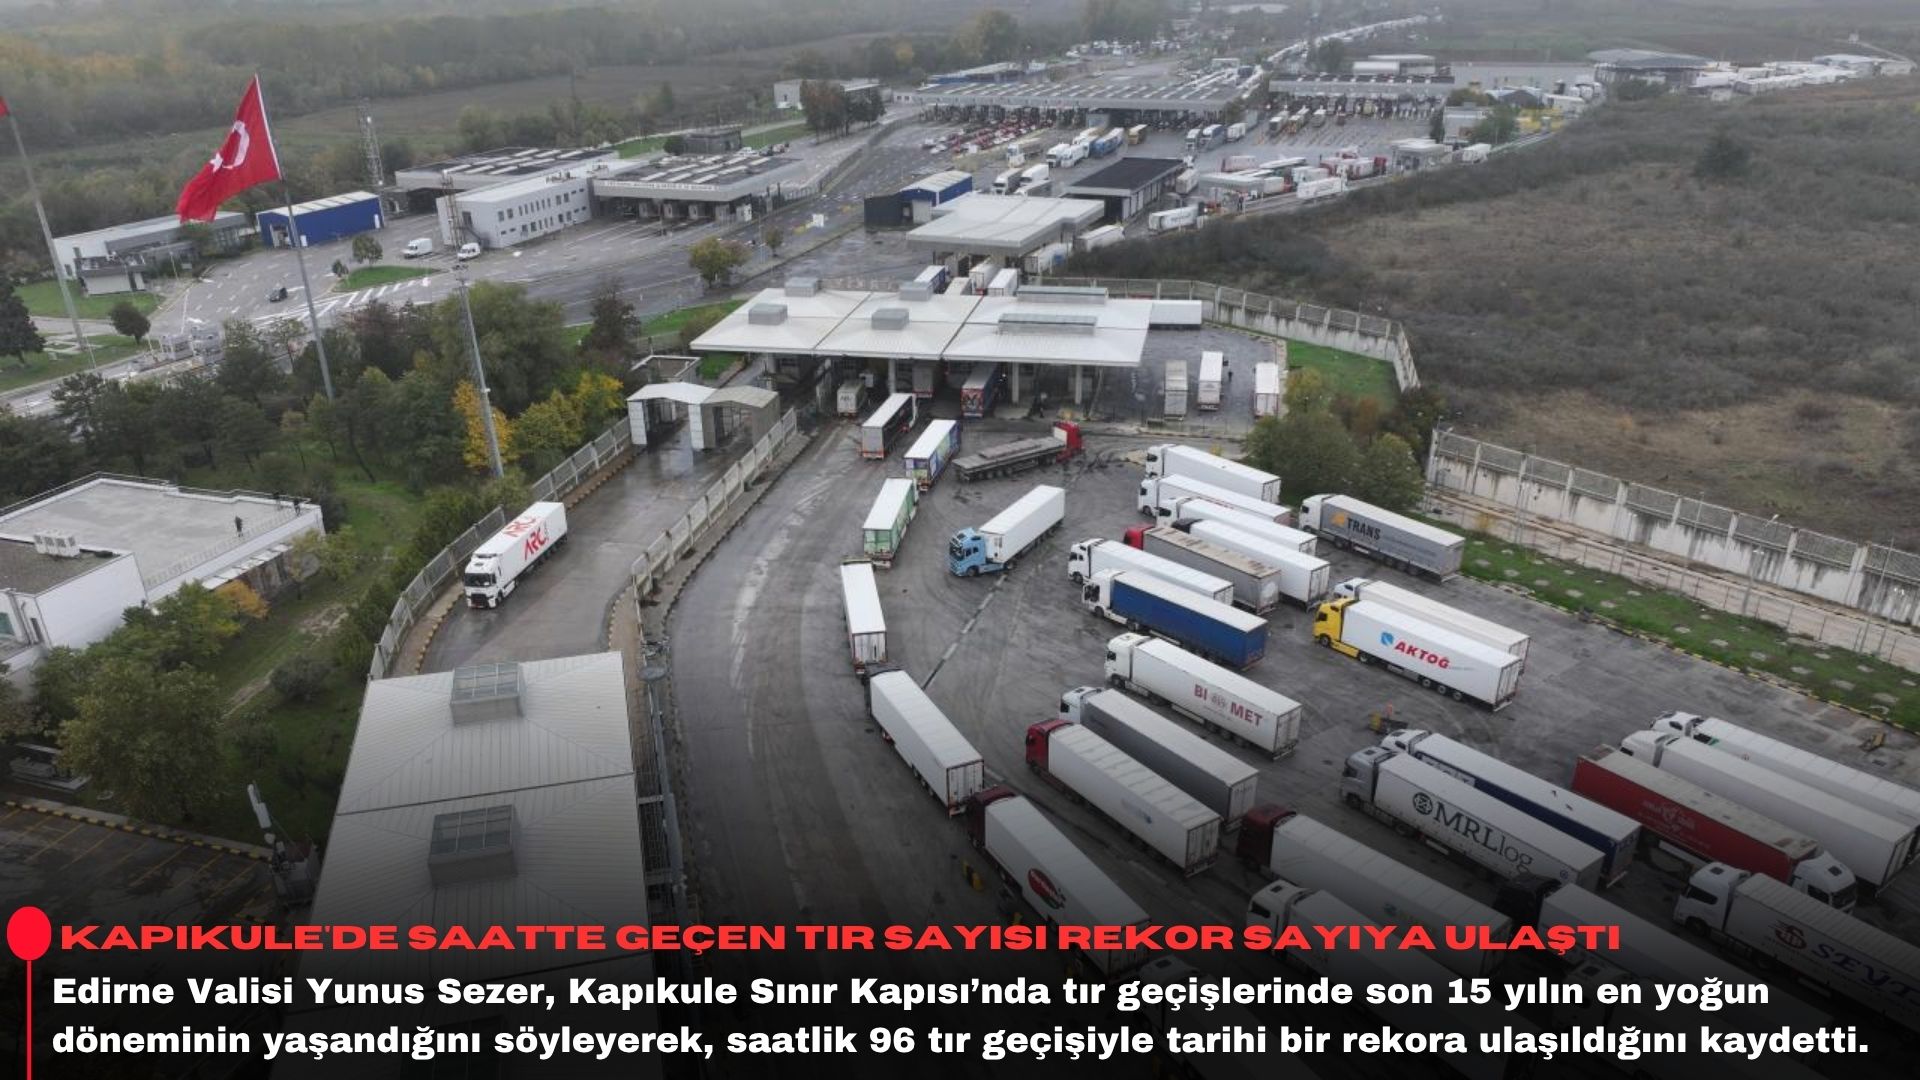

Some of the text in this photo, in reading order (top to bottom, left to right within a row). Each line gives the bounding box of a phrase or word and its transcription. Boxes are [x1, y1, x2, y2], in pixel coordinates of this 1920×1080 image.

[1346, 517, 1381, 541] TRANS
[1394, 640, 1451, 669] AKTOĞ
[1194, 684, 1208, 701] BI
[1231, 702, 1264, 726] MET
[1433, 801, 1534, 872] MRLlog
[1811, 943, 1920, 1007] SEYT
